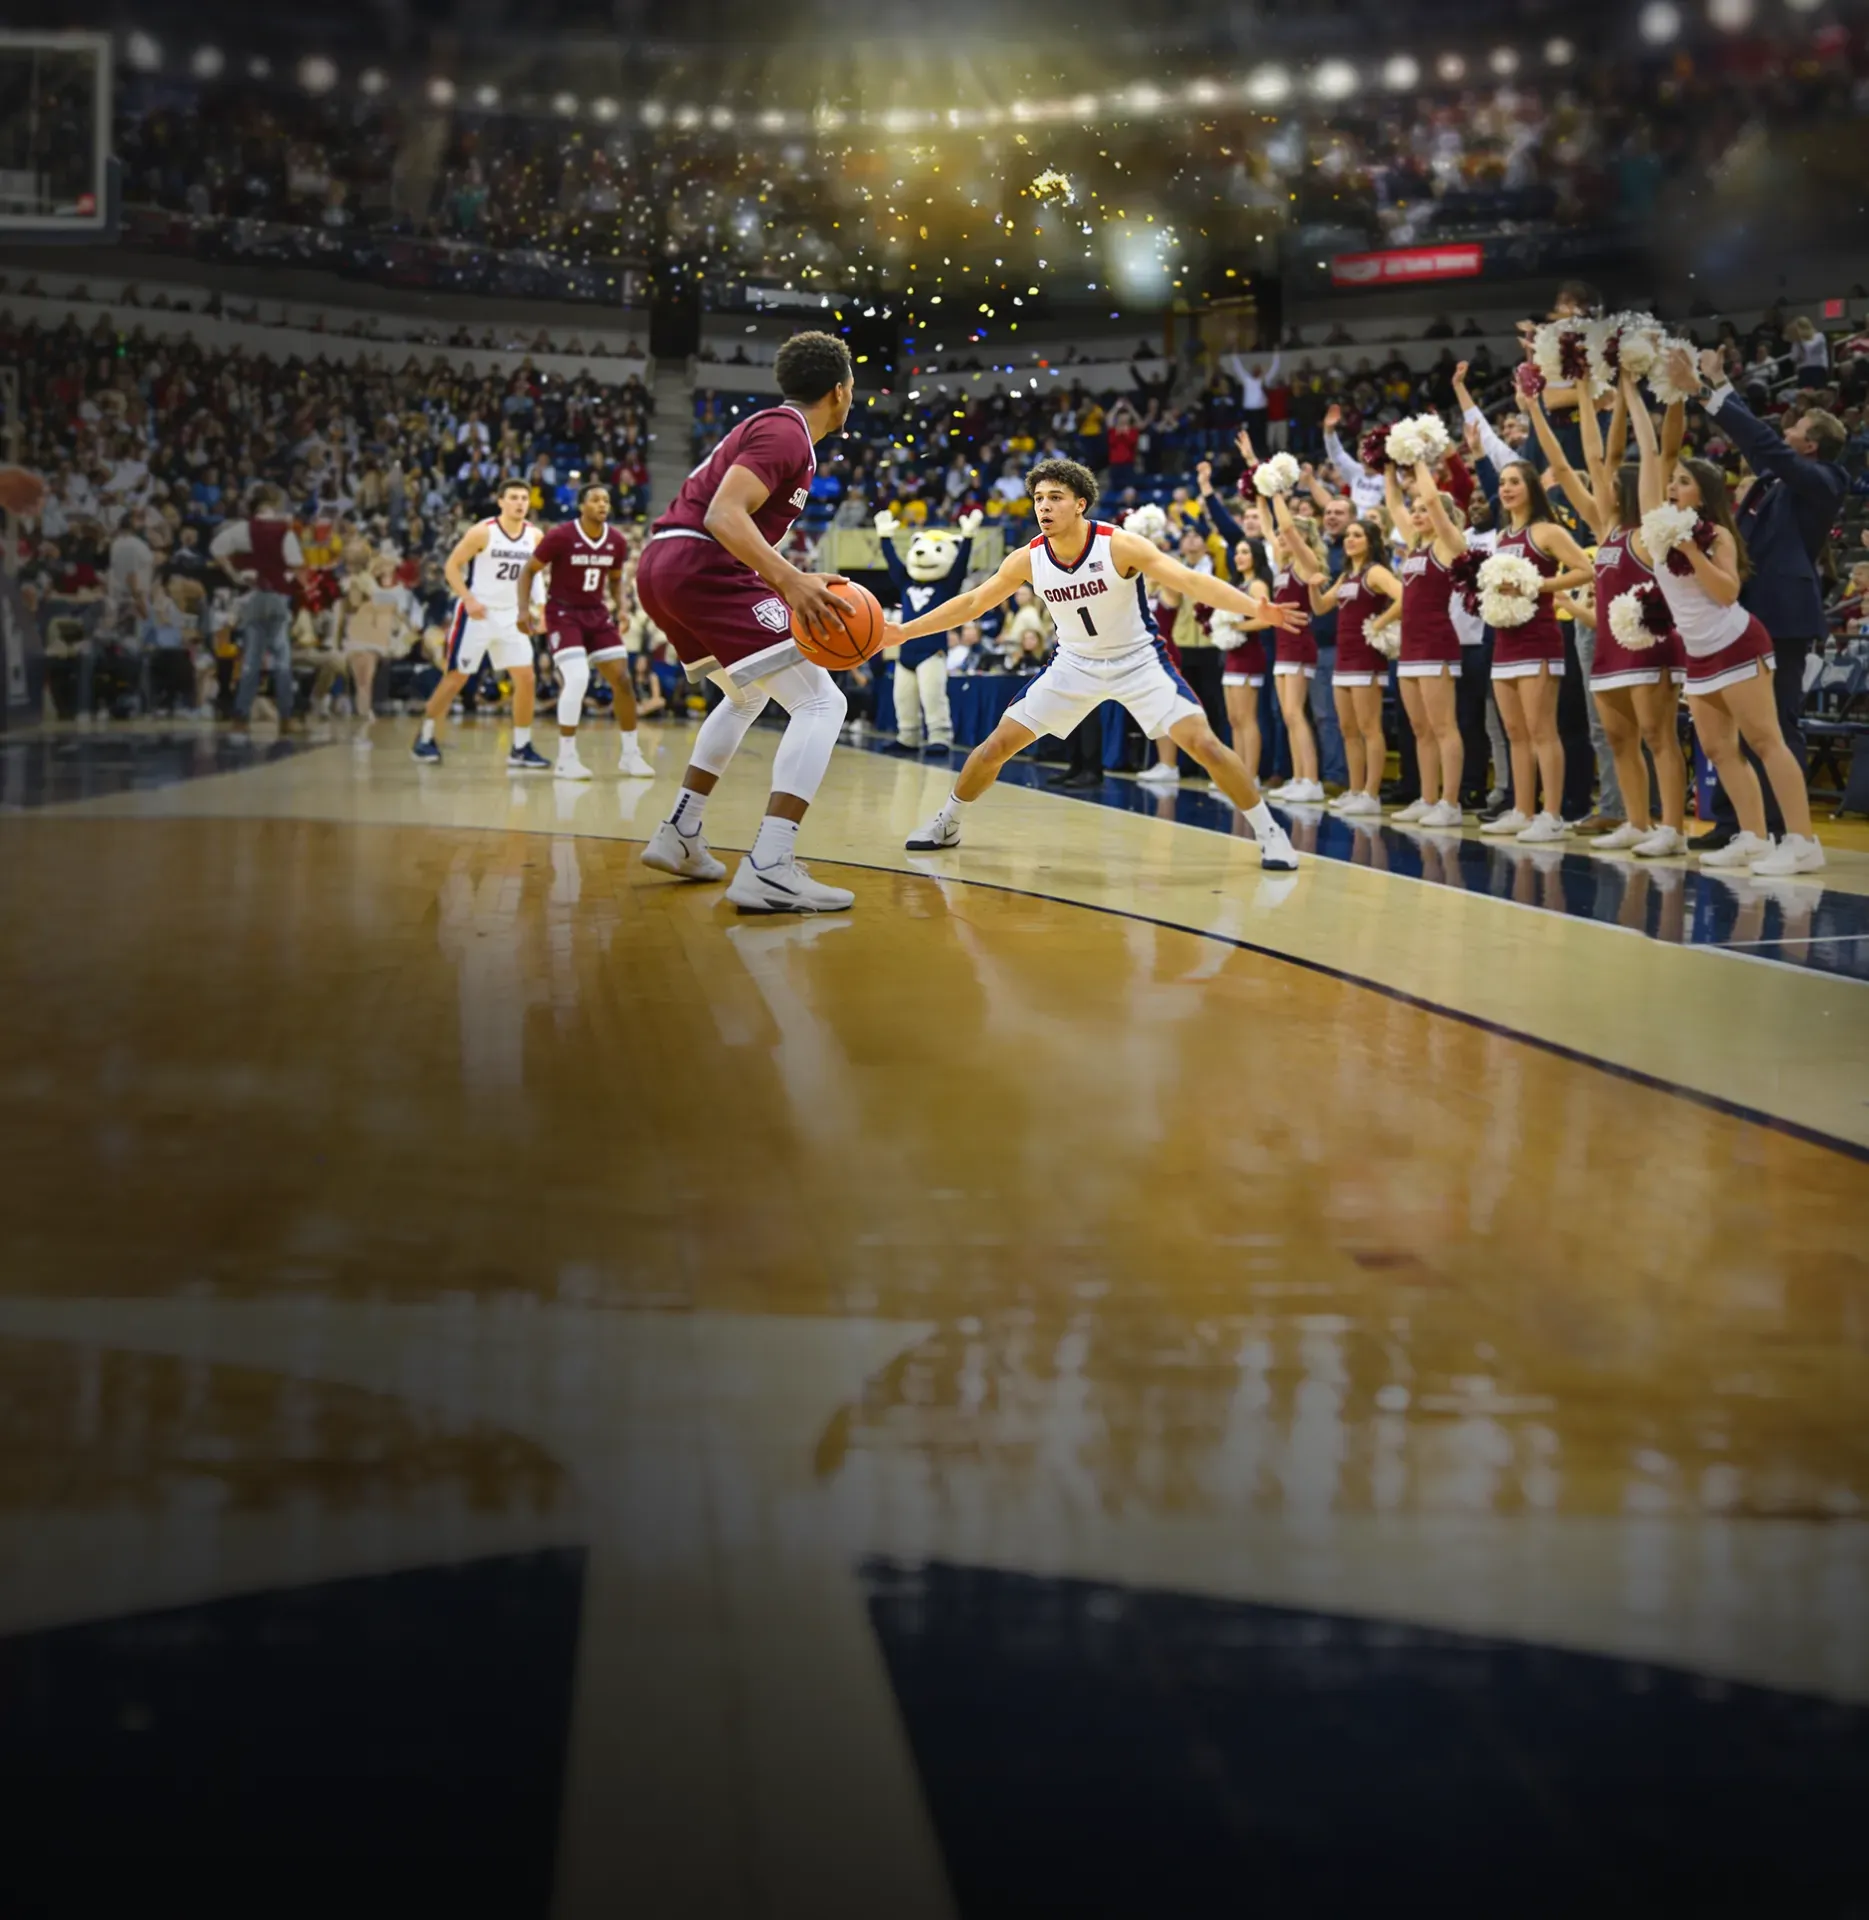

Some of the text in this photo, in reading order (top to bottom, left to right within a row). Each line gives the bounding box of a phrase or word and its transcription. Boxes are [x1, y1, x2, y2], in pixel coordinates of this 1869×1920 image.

[496, 562, 521, 581] 20
[582, 568, 601, 592] 13
[1043, 578, 1108, 603] GONZAGA
[1077, 606, 1098, 637] 1
